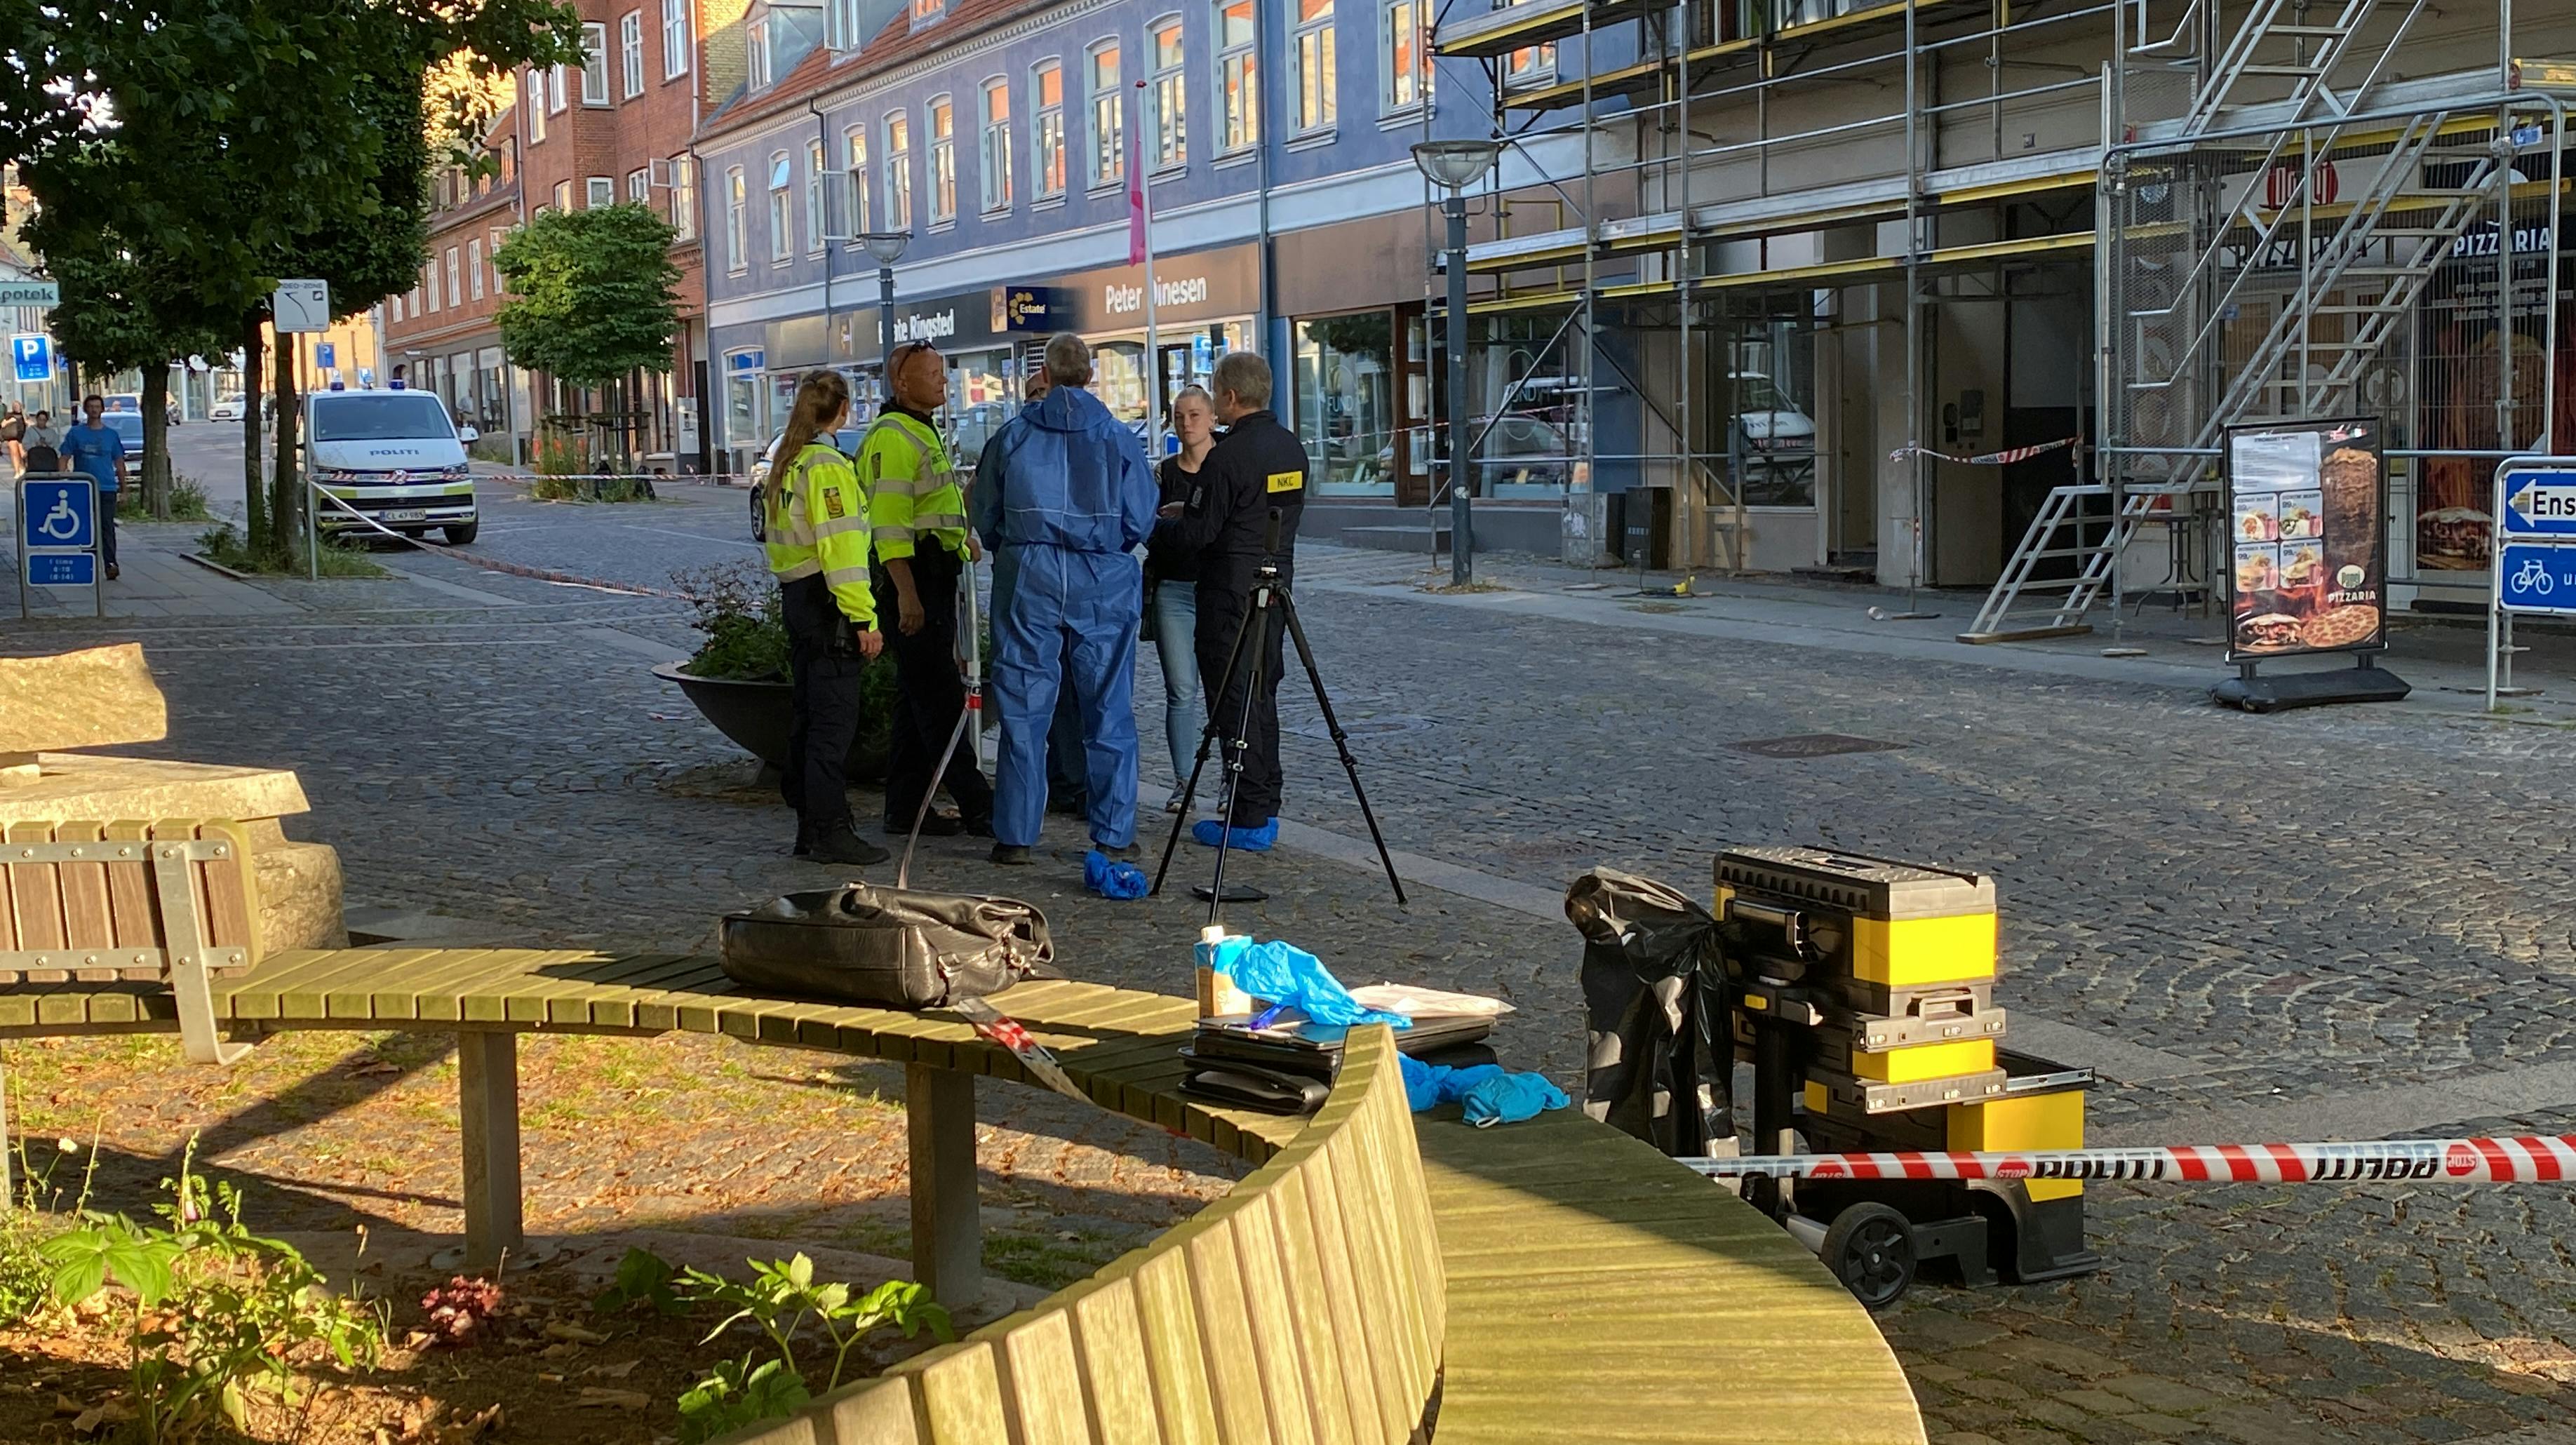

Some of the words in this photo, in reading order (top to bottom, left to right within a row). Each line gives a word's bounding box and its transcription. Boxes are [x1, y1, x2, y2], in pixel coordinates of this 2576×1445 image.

[2453, 227, 2550, 257] PIZZRIA
[0, 288, 54, 303] potek
[1106, 284, 1143, 314] Peter
[1019, 303, 1045, 314] Estate
[910, 308, 955, 342] Ringsted
[22, 340, 39, 362] P
[1510, 384, 1537, 403] UND
[1277, 476, 1294, 488] NKC
[2533, 491, 2576, 516] Ens
[2328, 590, 2376, 603] PIZZARIA
[1997, 1169, 2029, 1179] STOP
[2032, 1153, 2166, 1180] POLITI
[2309, 1144, 2441, 1181] POLITI
[2447, 1154, 2478, 1168] STOP
